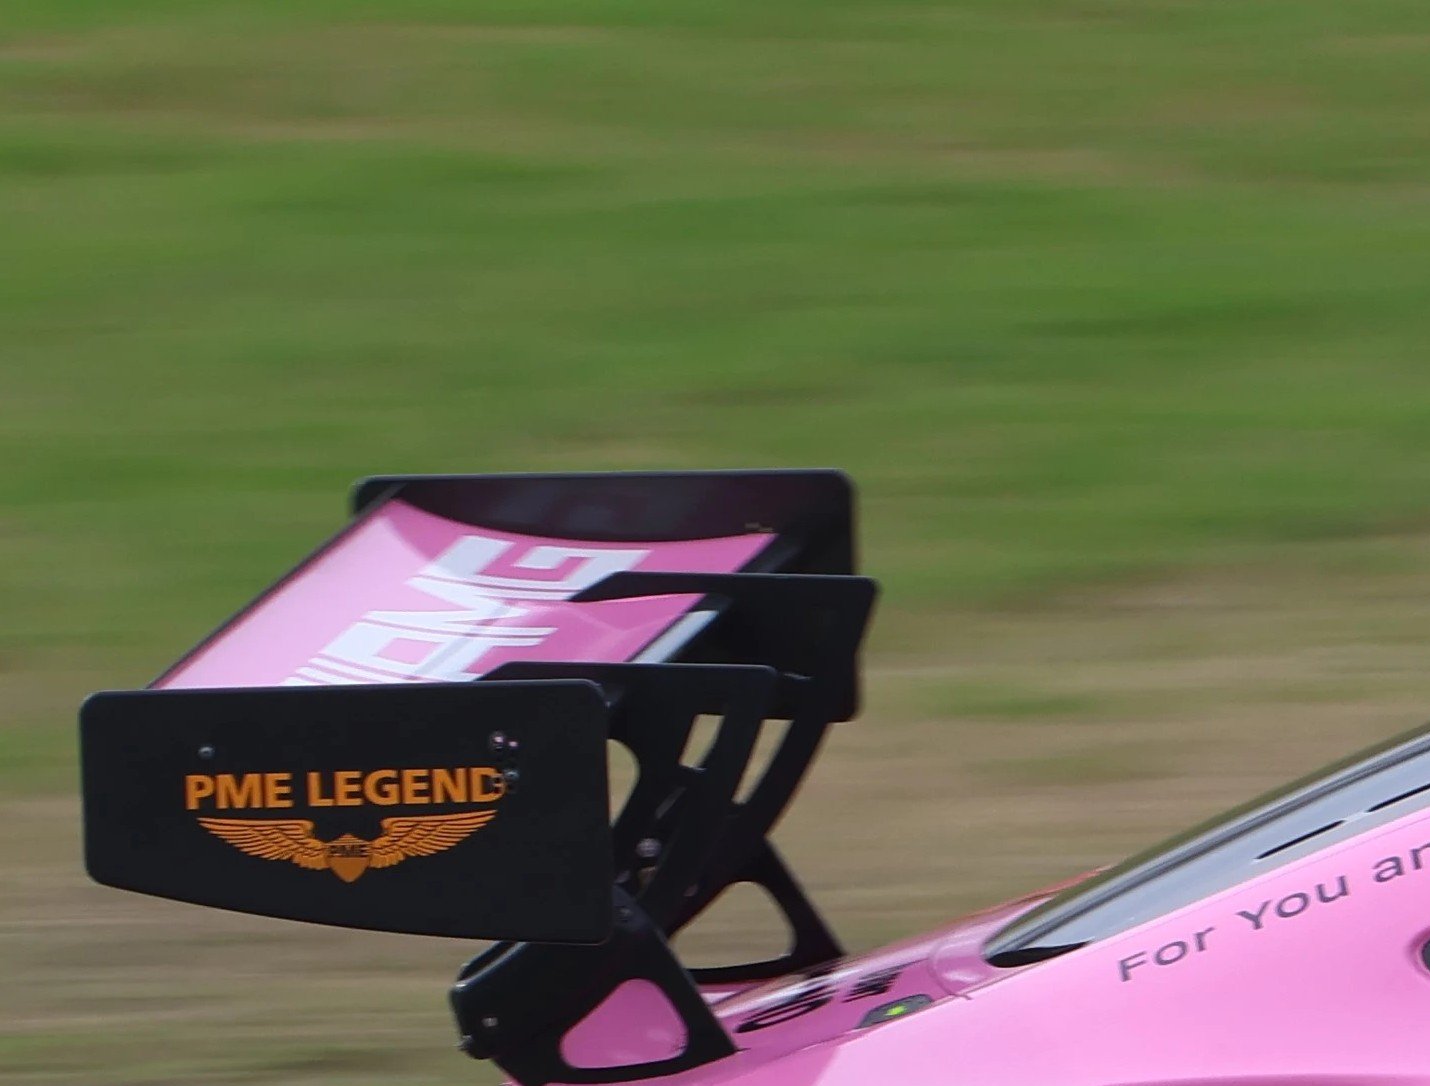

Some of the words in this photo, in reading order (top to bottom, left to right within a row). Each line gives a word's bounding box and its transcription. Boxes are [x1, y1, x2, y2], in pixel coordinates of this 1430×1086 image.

[185, 773, 294, 810] PME
[306, 767, 506, 807] LEGEND
[1117, 926, 1216, 983] For
[1235, 874, 1352, 931] You
